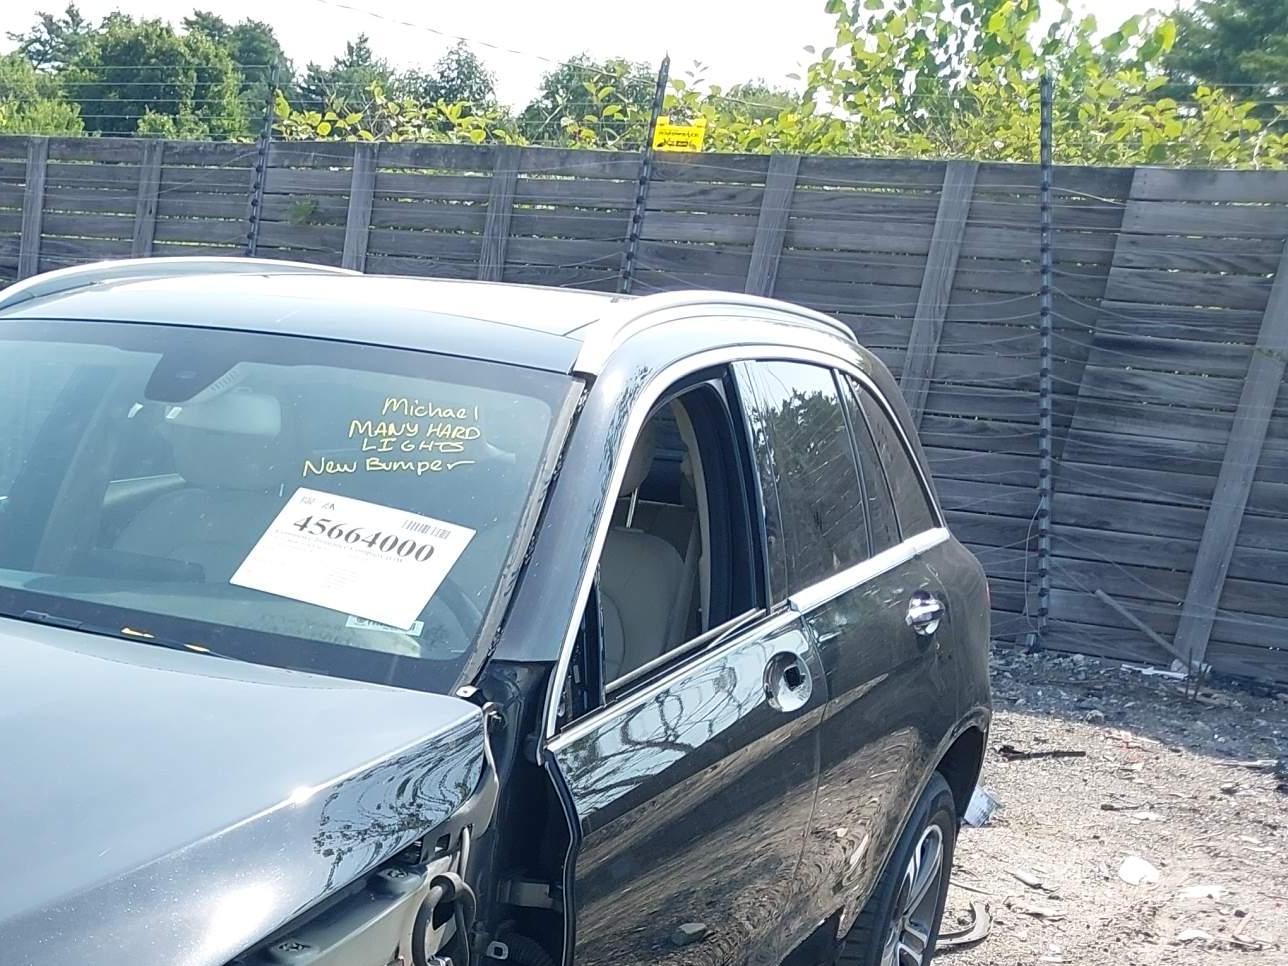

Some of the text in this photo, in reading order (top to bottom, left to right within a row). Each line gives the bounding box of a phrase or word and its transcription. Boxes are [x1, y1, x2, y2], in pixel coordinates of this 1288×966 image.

[382, 396, 479, 421] Michael
[348, 420, 481, 440] MANY HARD
[302, 457, 476, 477] New Bumper
[293, 514, 435, 563] 45664000
